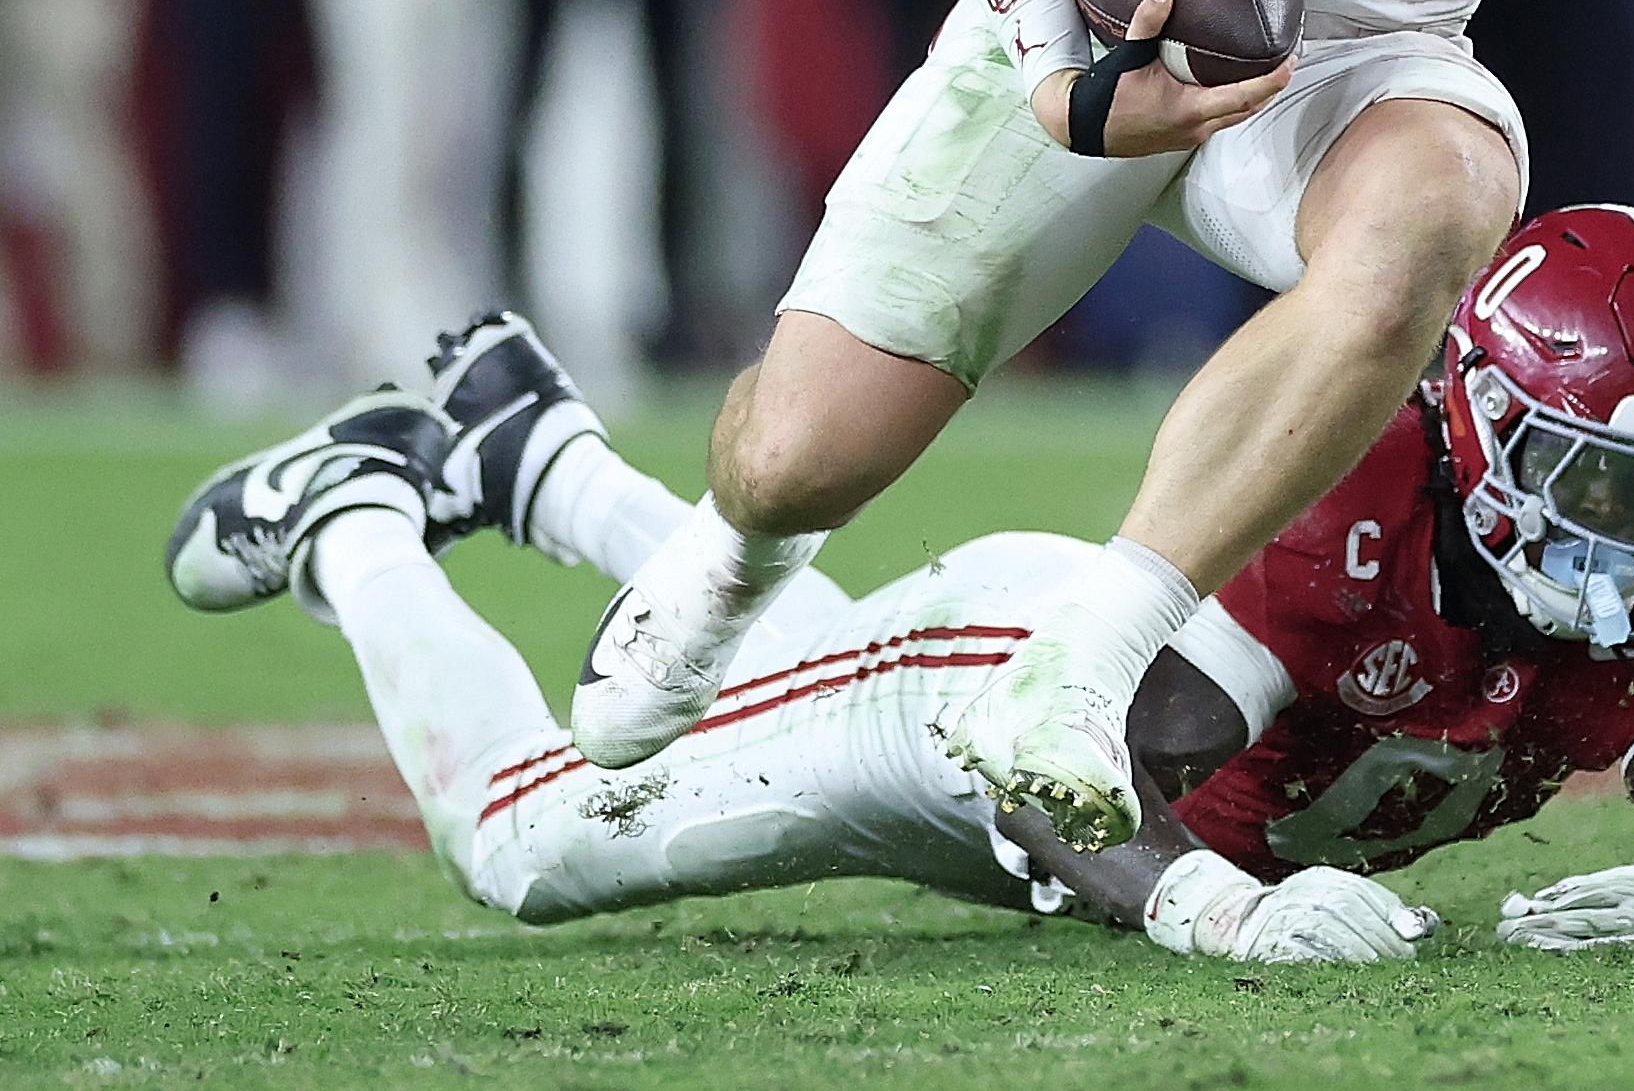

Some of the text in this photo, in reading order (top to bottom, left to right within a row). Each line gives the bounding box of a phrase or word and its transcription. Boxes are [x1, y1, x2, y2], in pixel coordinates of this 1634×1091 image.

[1475, 244, 1547, 320] 0
[1345, 520, 1381, 580] C
[1356, 639, 1418, 696] SEC
